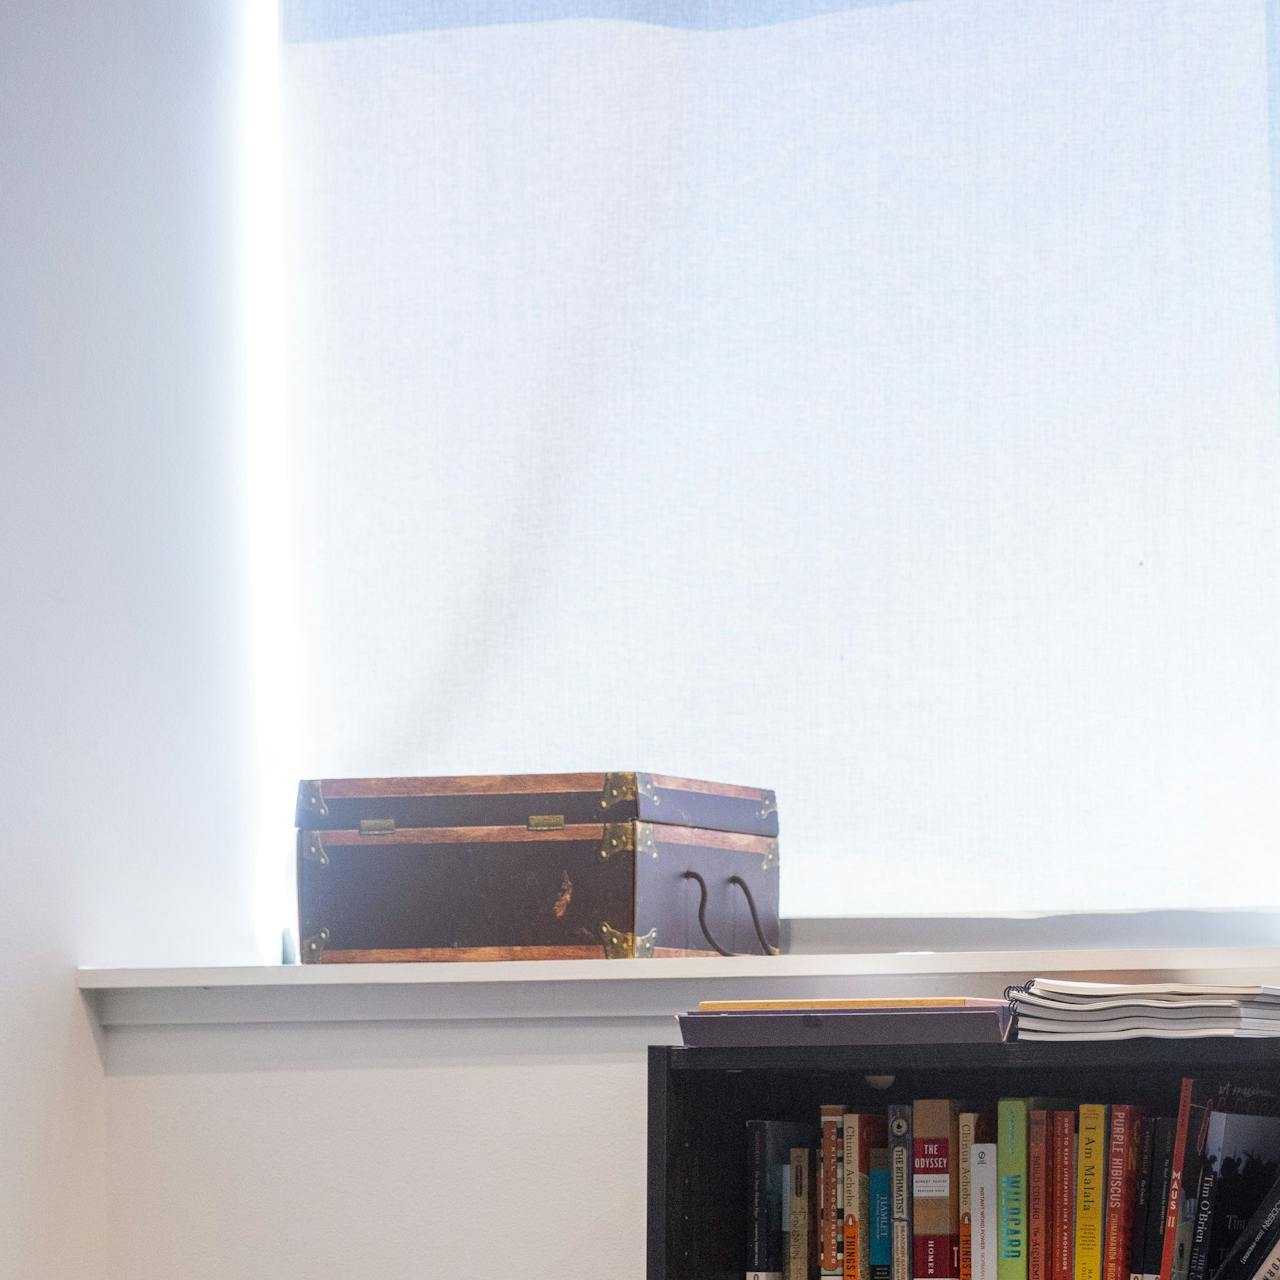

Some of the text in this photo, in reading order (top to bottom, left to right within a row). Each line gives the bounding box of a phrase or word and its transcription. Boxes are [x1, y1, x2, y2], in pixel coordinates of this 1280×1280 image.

[830, 1127, 837, 1141] TO
[924, 1144, 938, 1156] THE
[1064, 1136, 1069, 1146] TO
[1084, 1136, 1096, 1160] Am
[846, 1125, 854, 1208] Chinua Achebe
[894, 1148, 904, 1167] THE
[914, 1156, 948, 1169] ODYSSEY
[961, 1123, 972, 1207] Chinua Achebe
[1110, 1112, 1126, 1209] PURPLE HIBISCUS
[830, 1177, 837, 1185] A
[894, 1168, 904, 1216] RITHMATIST
[1032, 1155, 1041, 1220] PAULO COELHO
[1082, 1164, 1096, 1212] Malala
[1168, 1170, 1182, 1228] MAUS II
[880, 1196, 889, 1238] HAMLET
[1001, 1174, 1022, 1260] WILDCARD
[1195, 1175, 1214, 1243] Tim O'Brien
[846, 1234, 857, 1271] THINGS
[962, 1232, 972, 1270] THINGS
[1108, 1213, 1119, 1260] CHIMAMANDA
[1190, 1246, 1199, 1270] THEY
